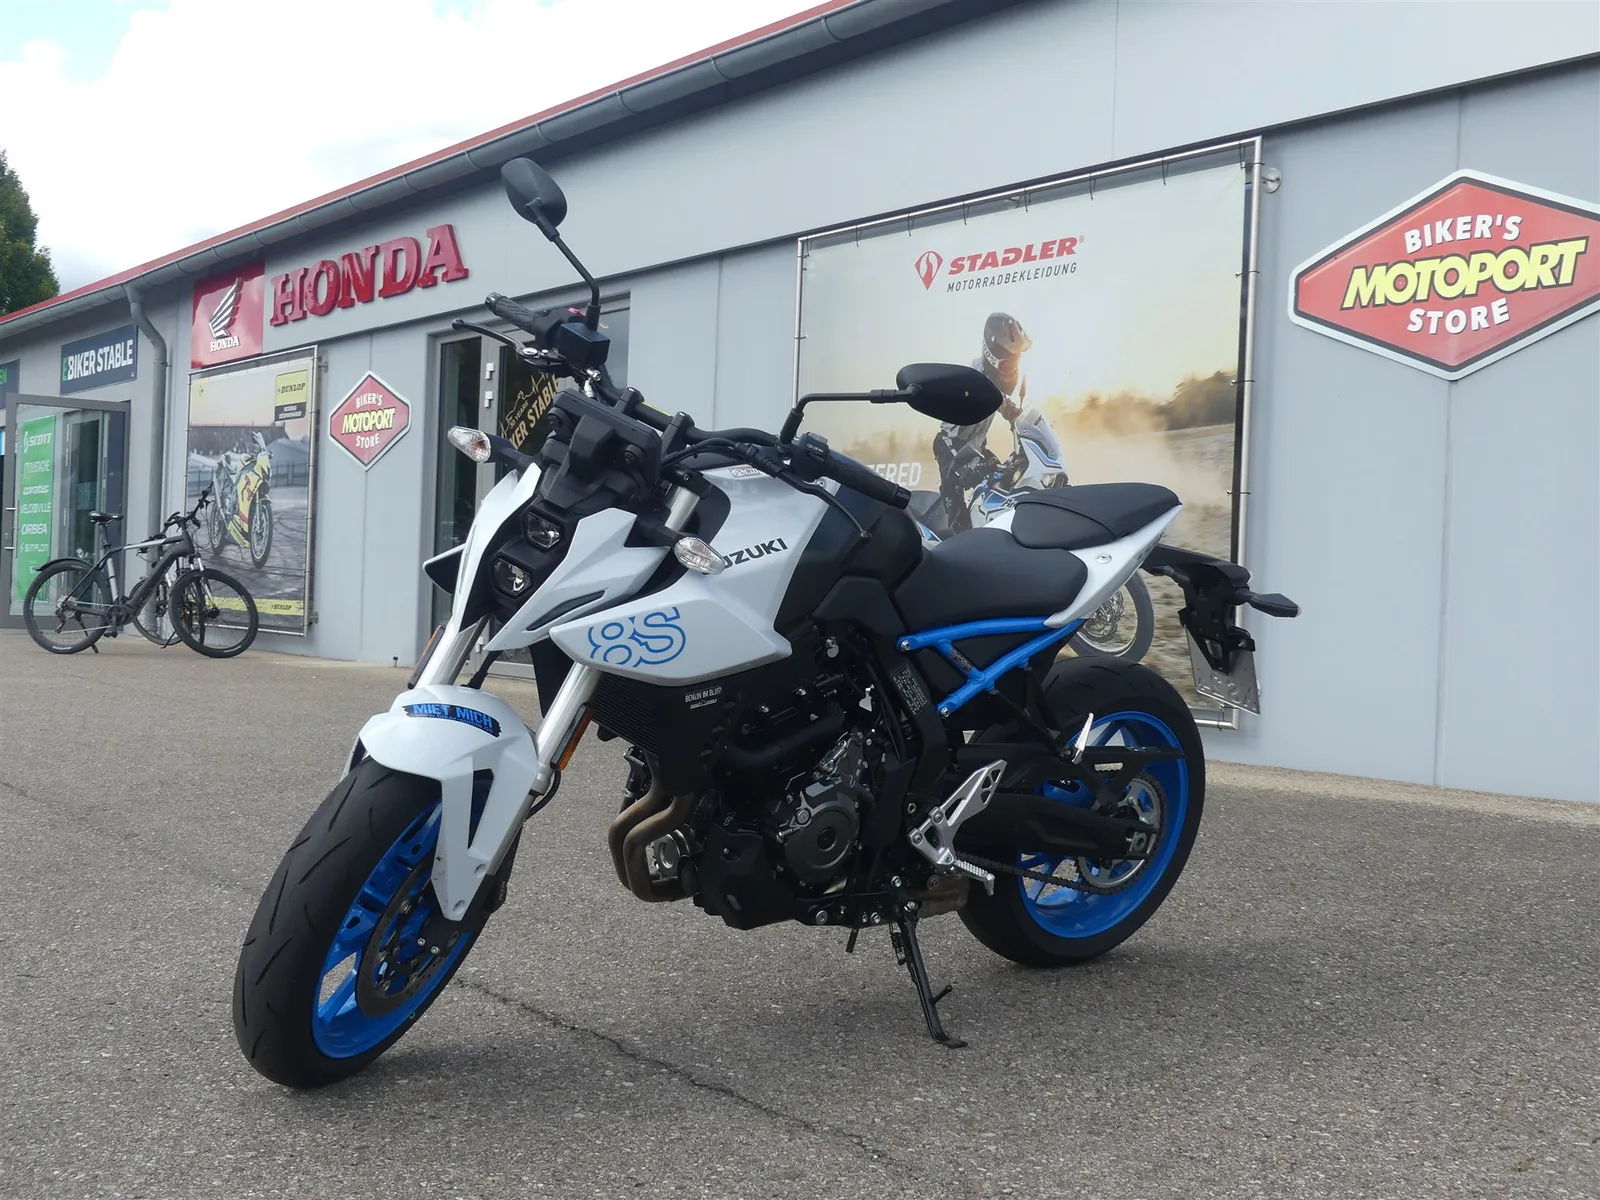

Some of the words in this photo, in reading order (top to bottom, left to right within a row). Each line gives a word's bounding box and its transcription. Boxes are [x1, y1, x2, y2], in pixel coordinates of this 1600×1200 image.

[1404, 214, 1523, 254] BIKER'S
[270, 224, 469, 327] HONDA
[946, 262, 1078, 294] MOTORRADBEKLEIDUNG
[1340, 236, 1589, 311] MOTOPORT
[1407, 298, 1511, 335] STORE
[96, 339, 134, 373] STABLE
[210, 335, 240, 352] HONDA
[280, 382, 306, 394] DUNLOP
[355, 392, 383, 409] BIKER'S
[341, 407, 396, 435] MOTOPORT
[29, 433, 52, 447] SCOTT
[355, 433, 380, 449] STORE
[21, 524, 48, 535] ORBEA
[413, 704, 450, 716] MIET
[455, 707, 493, 728] MICH
